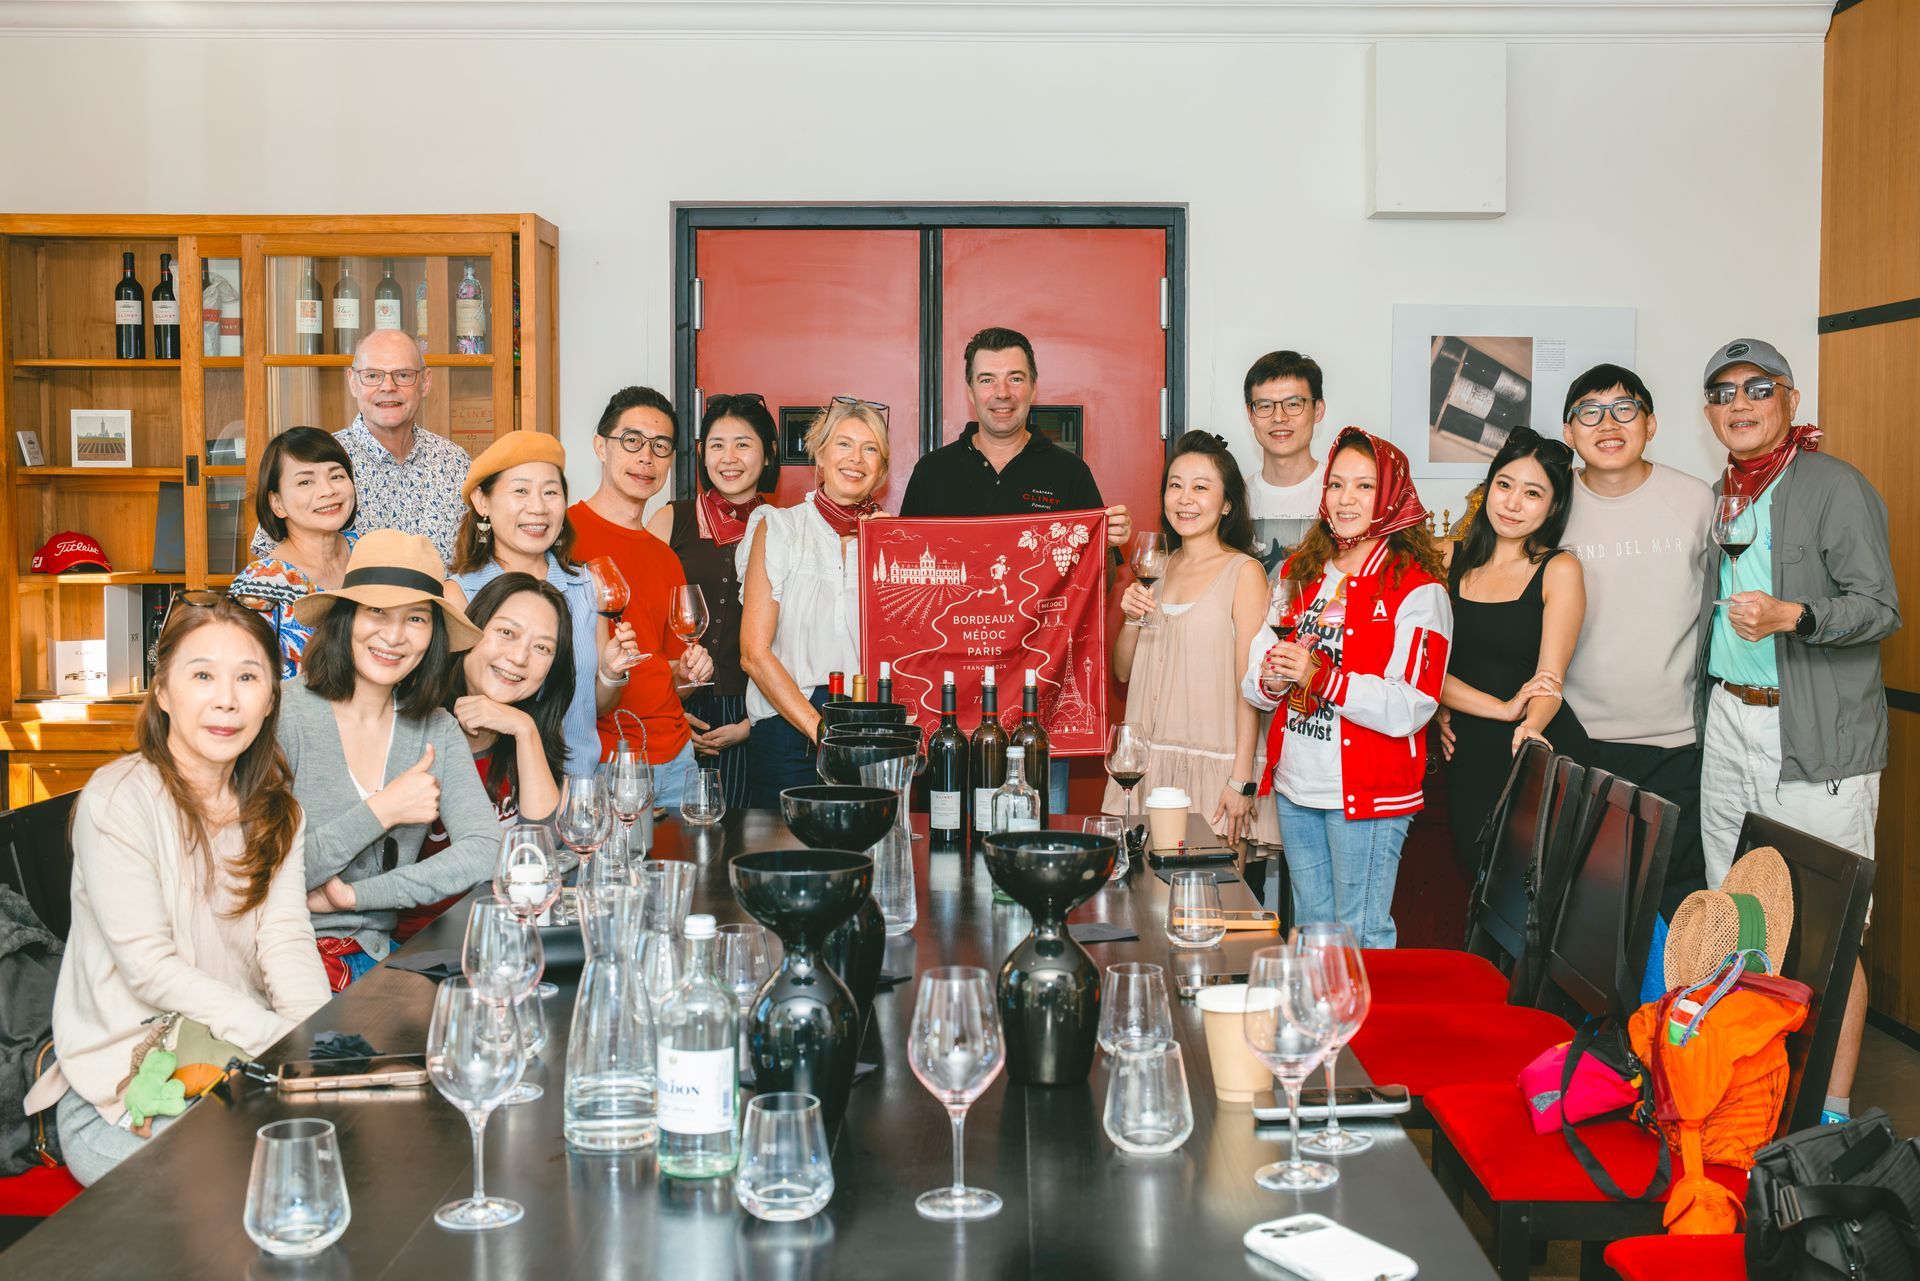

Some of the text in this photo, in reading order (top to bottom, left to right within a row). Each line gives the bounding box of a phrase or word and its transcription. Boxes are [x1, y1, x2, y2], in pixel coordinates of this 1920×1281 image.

[1023, 493, 1061, 505] CLINET
[54, 540, 100, 557] Titleist
[1577, 537, 1682, 560] AND DEL MAR
[32, 556, 44, 568] FJ
[1373, 599, 1388, 617] A
[953, 614, 1015, 625] BORDEAUX
[963, 628, 1006, 640] MÉDOC
[967, 646, 1002, 656] PARIS
